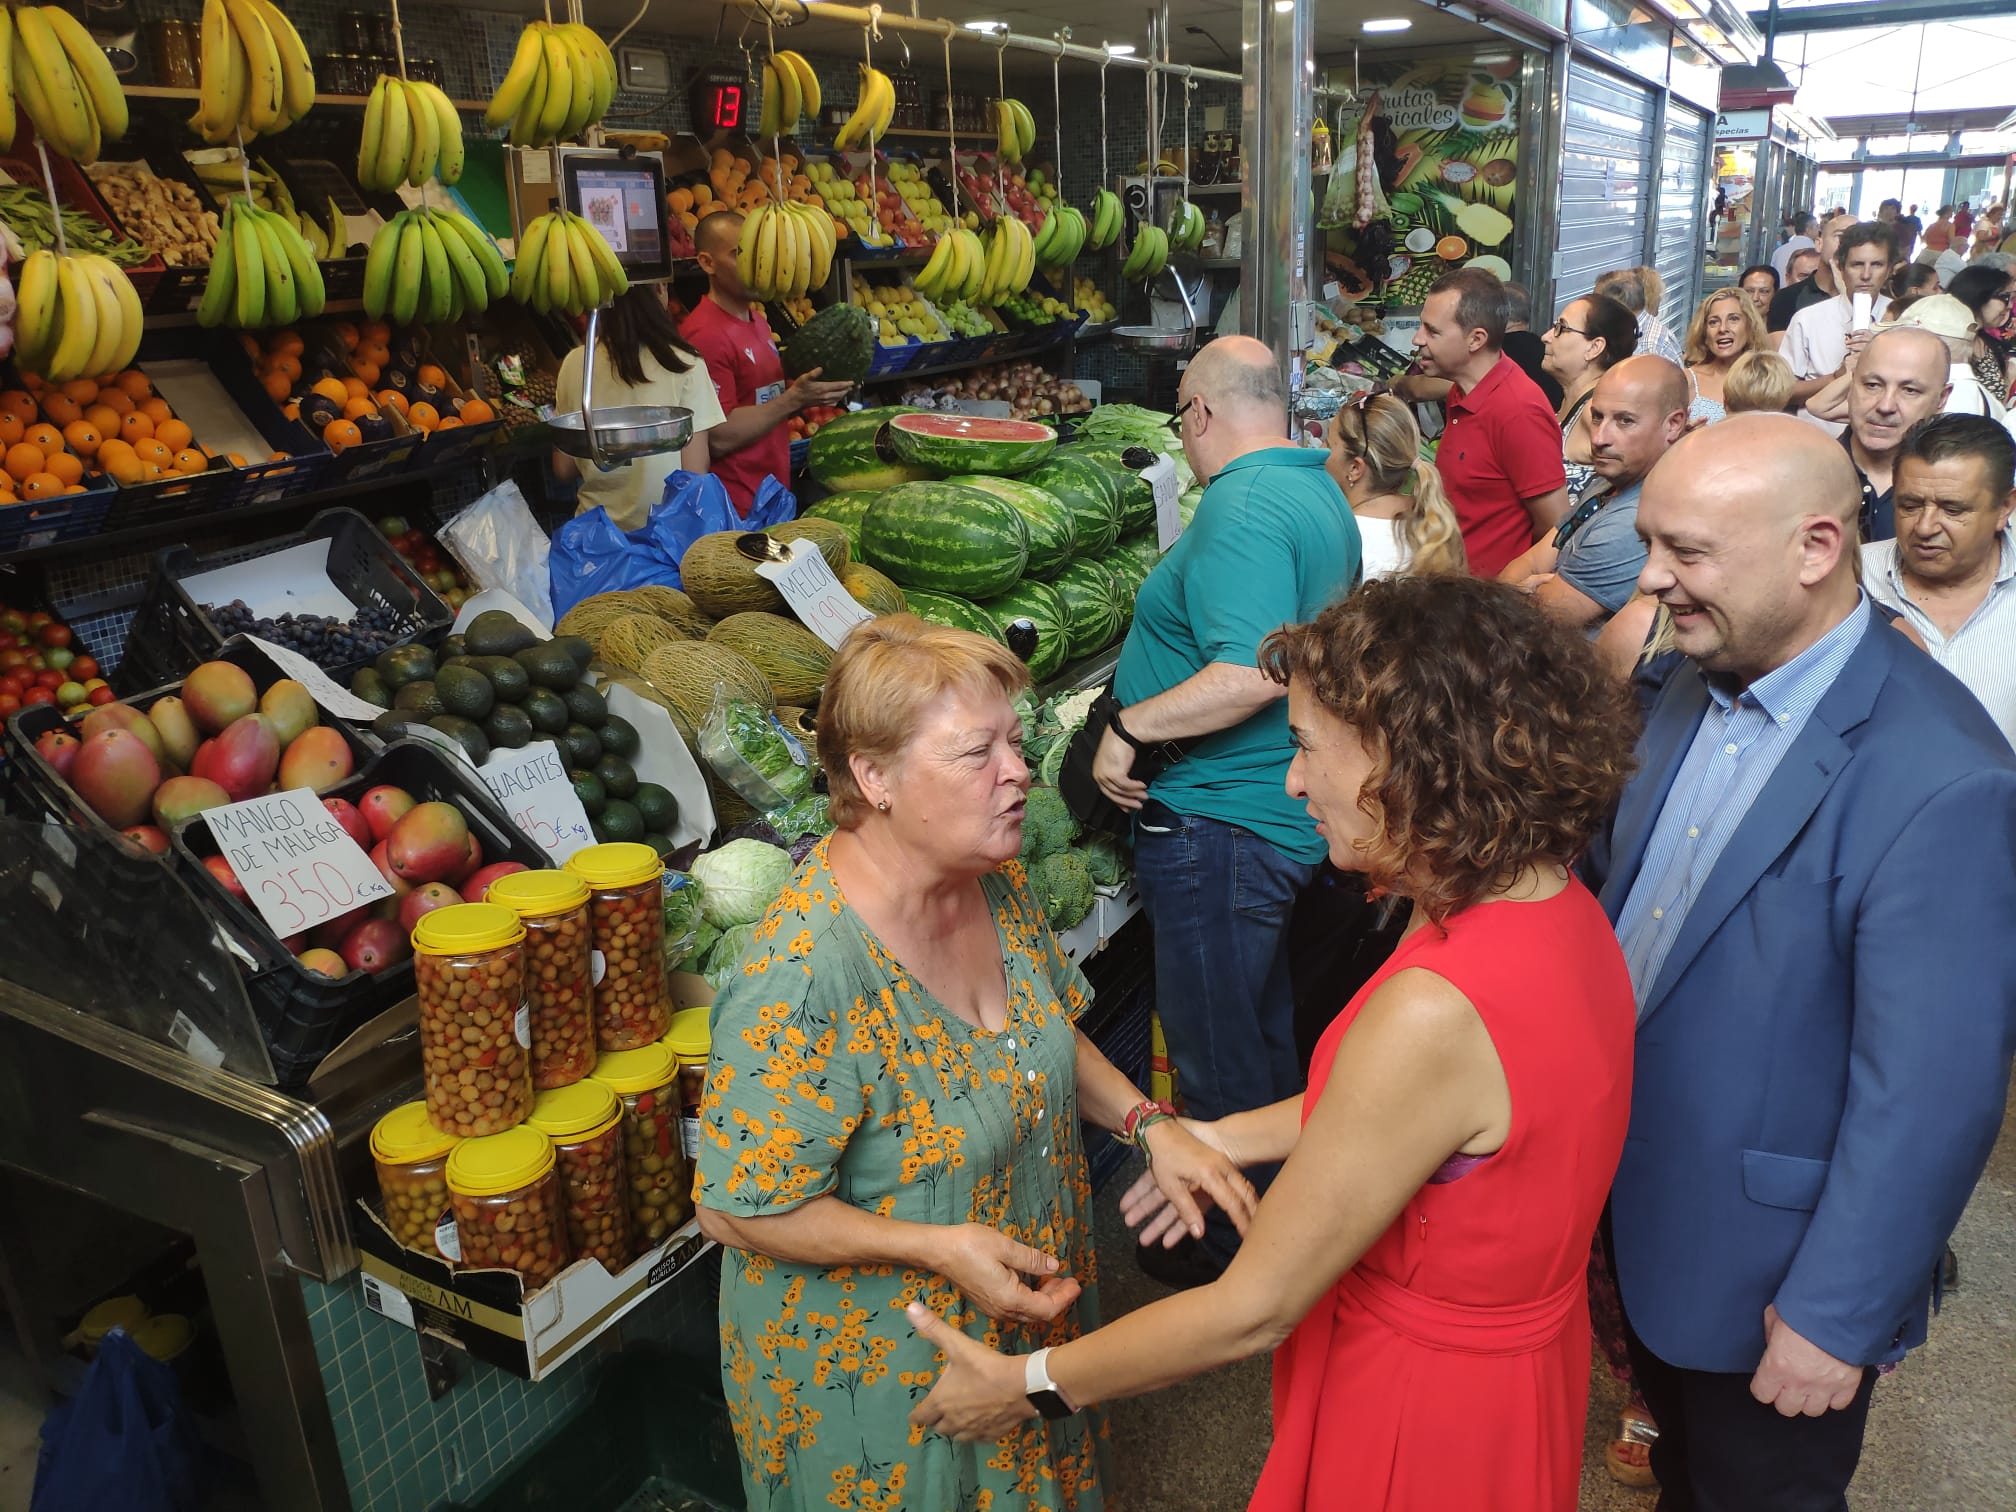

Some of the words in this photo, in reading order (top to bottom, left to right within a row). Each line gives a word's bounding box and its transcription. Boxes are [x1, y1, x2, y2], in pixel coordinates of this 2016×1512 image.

[715, 86, 740, 127] 13
[1360, 86, 1433, 109] rutas
[1715, 127, 1750, 137] specias
[210, 799, 305, 843] MANGO
[230, 843, 264, 872] DE
[262, 821, 350, 864] MALAGA
